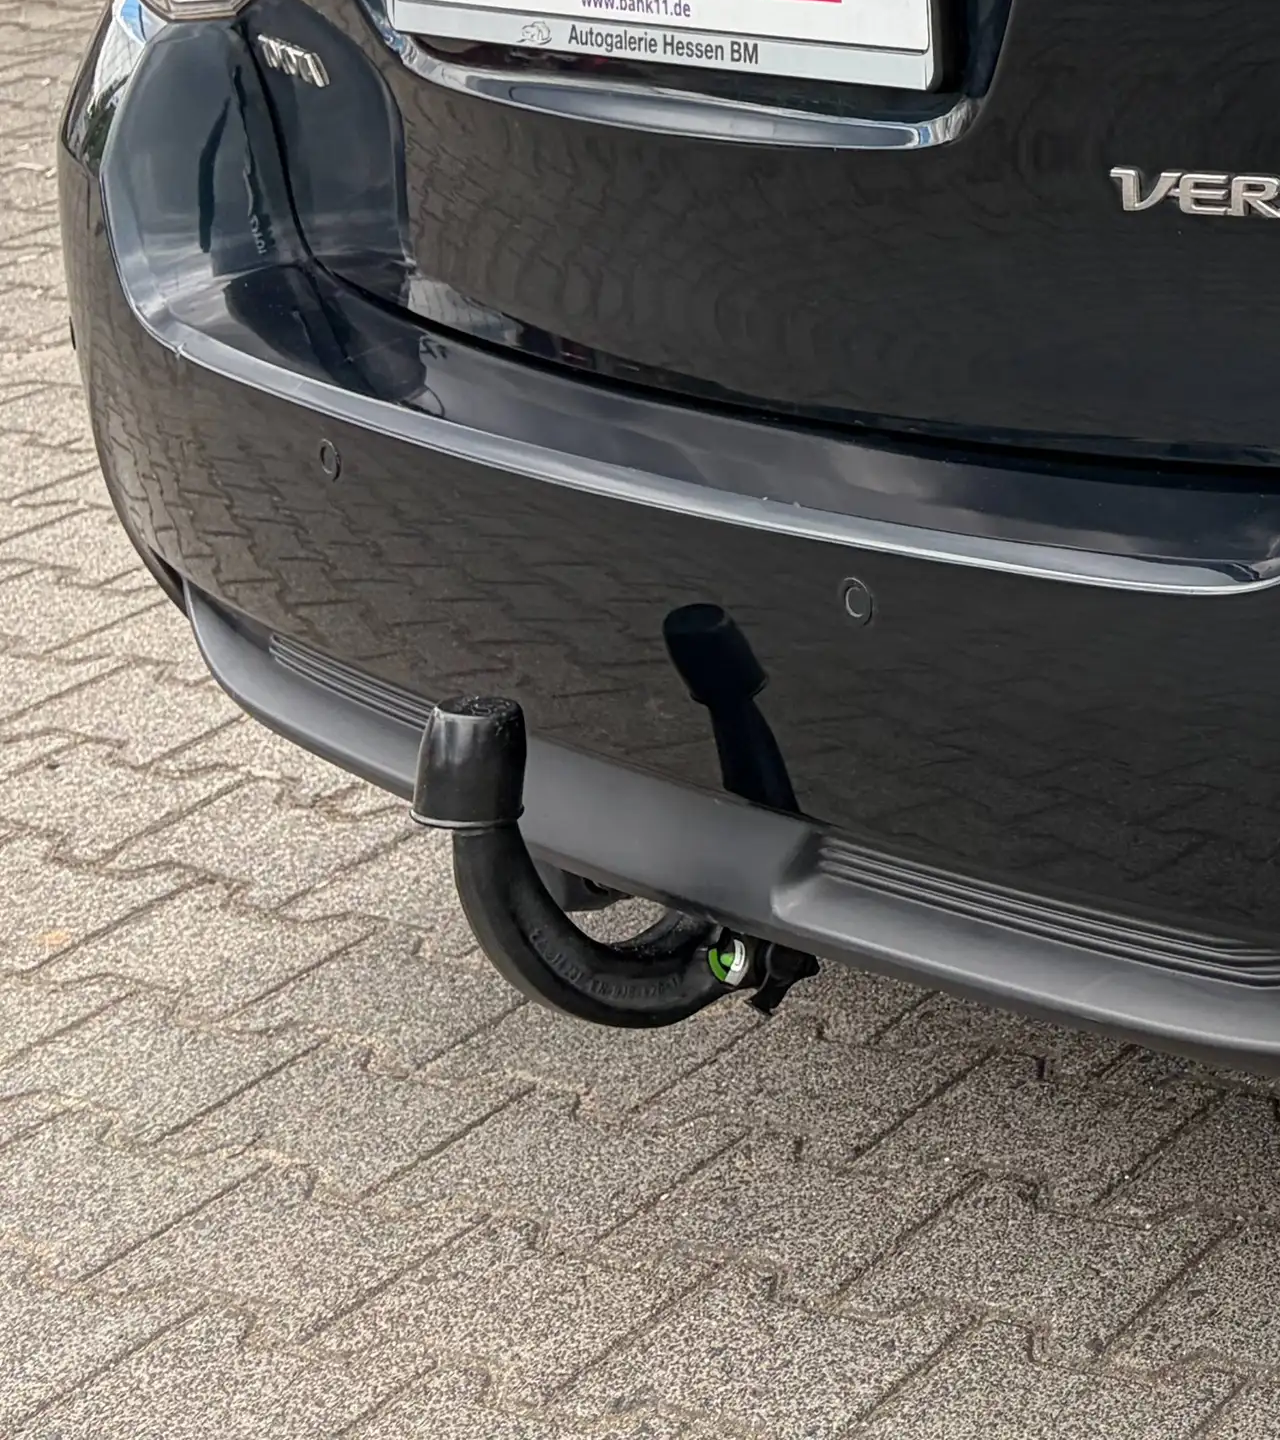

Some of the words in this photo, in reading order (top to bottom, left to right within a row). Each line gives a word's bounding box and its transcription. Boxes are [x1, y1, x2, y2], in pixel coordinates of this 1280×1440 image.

[568, 24, 658, 54] Autogalerie
[663, 33, 725, 62] Hessen
[730, 40, 759, 65] BM
